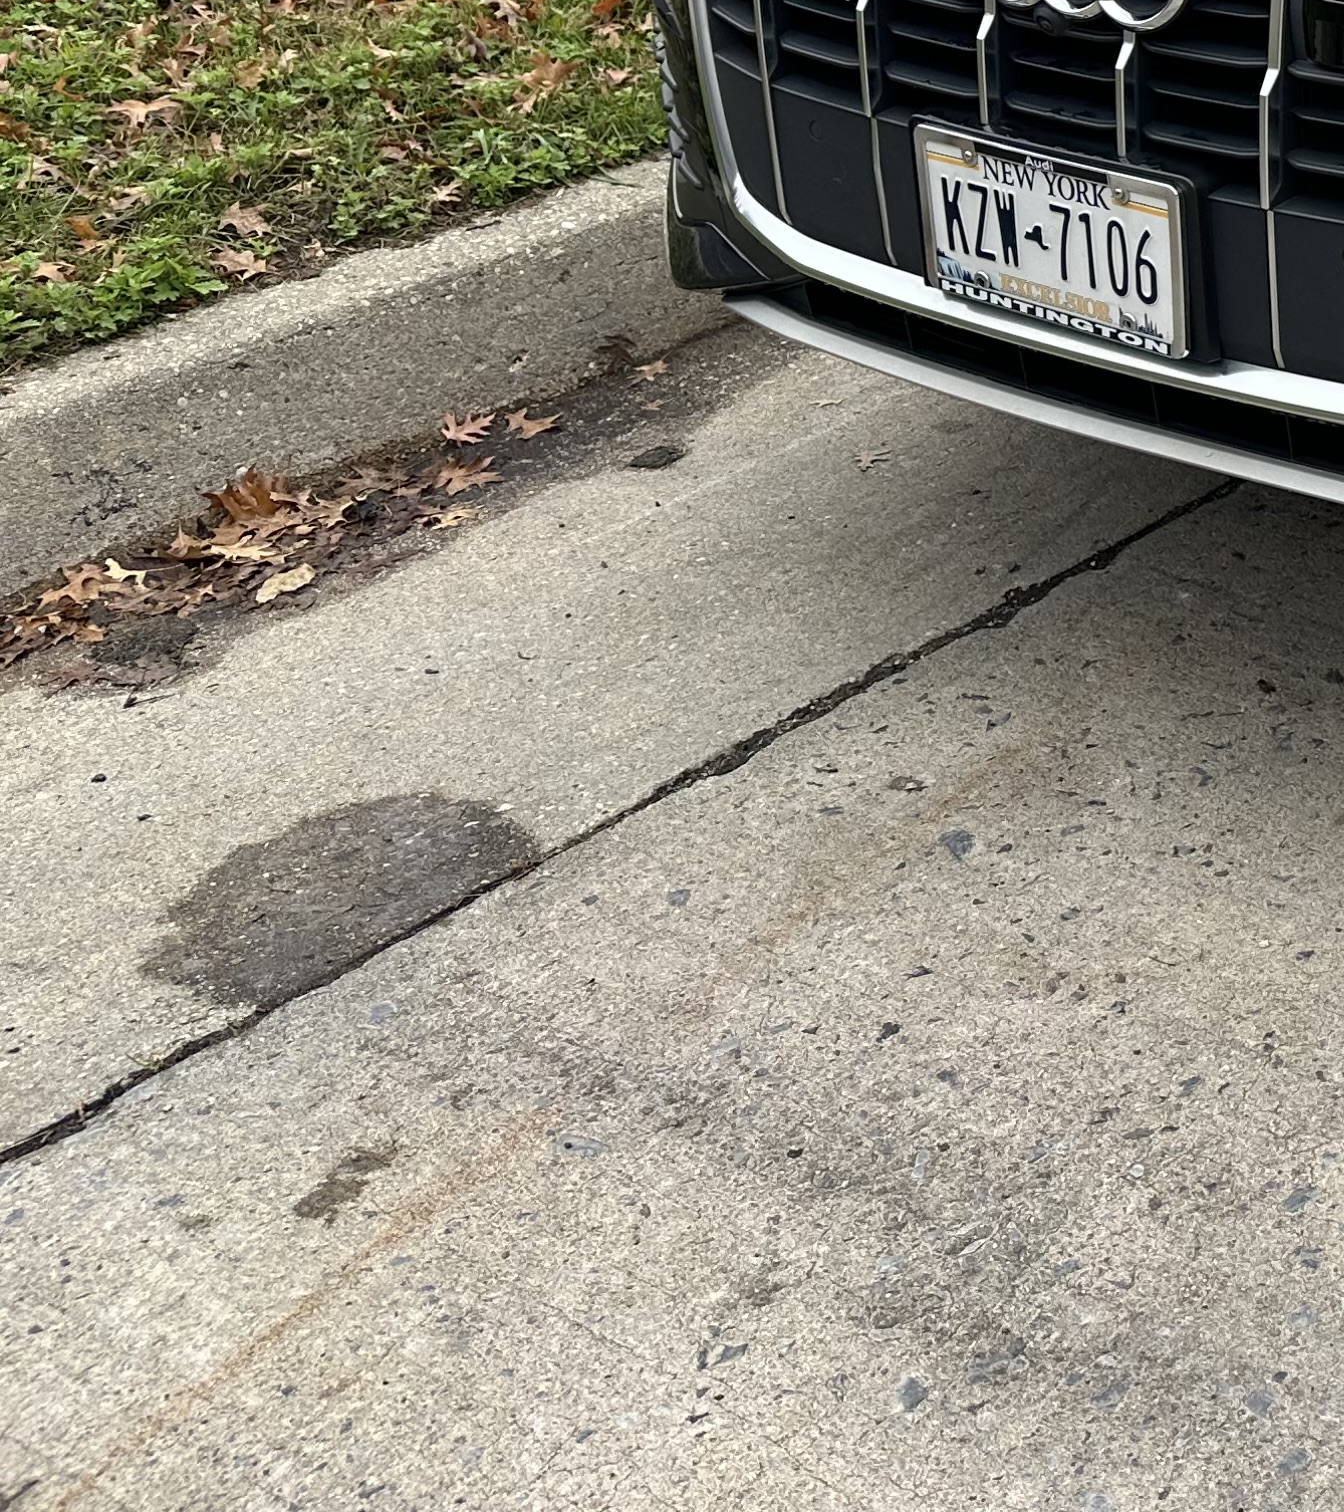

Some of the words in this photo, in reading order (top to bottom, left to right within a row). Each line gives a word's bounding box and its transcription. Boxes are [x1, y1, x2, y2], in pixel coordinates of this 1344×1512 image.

[981, 156, 1037, 192] NEW
[1044, 172, 1111, 211] YORK
[1024, 155, 1054, 172] Audi
[1049, 203, 1158, 305] 7106
[940, 279, 1171, 357] HUNTINGTON
[1000, 273, 1113, 324] EXCELSIOR
